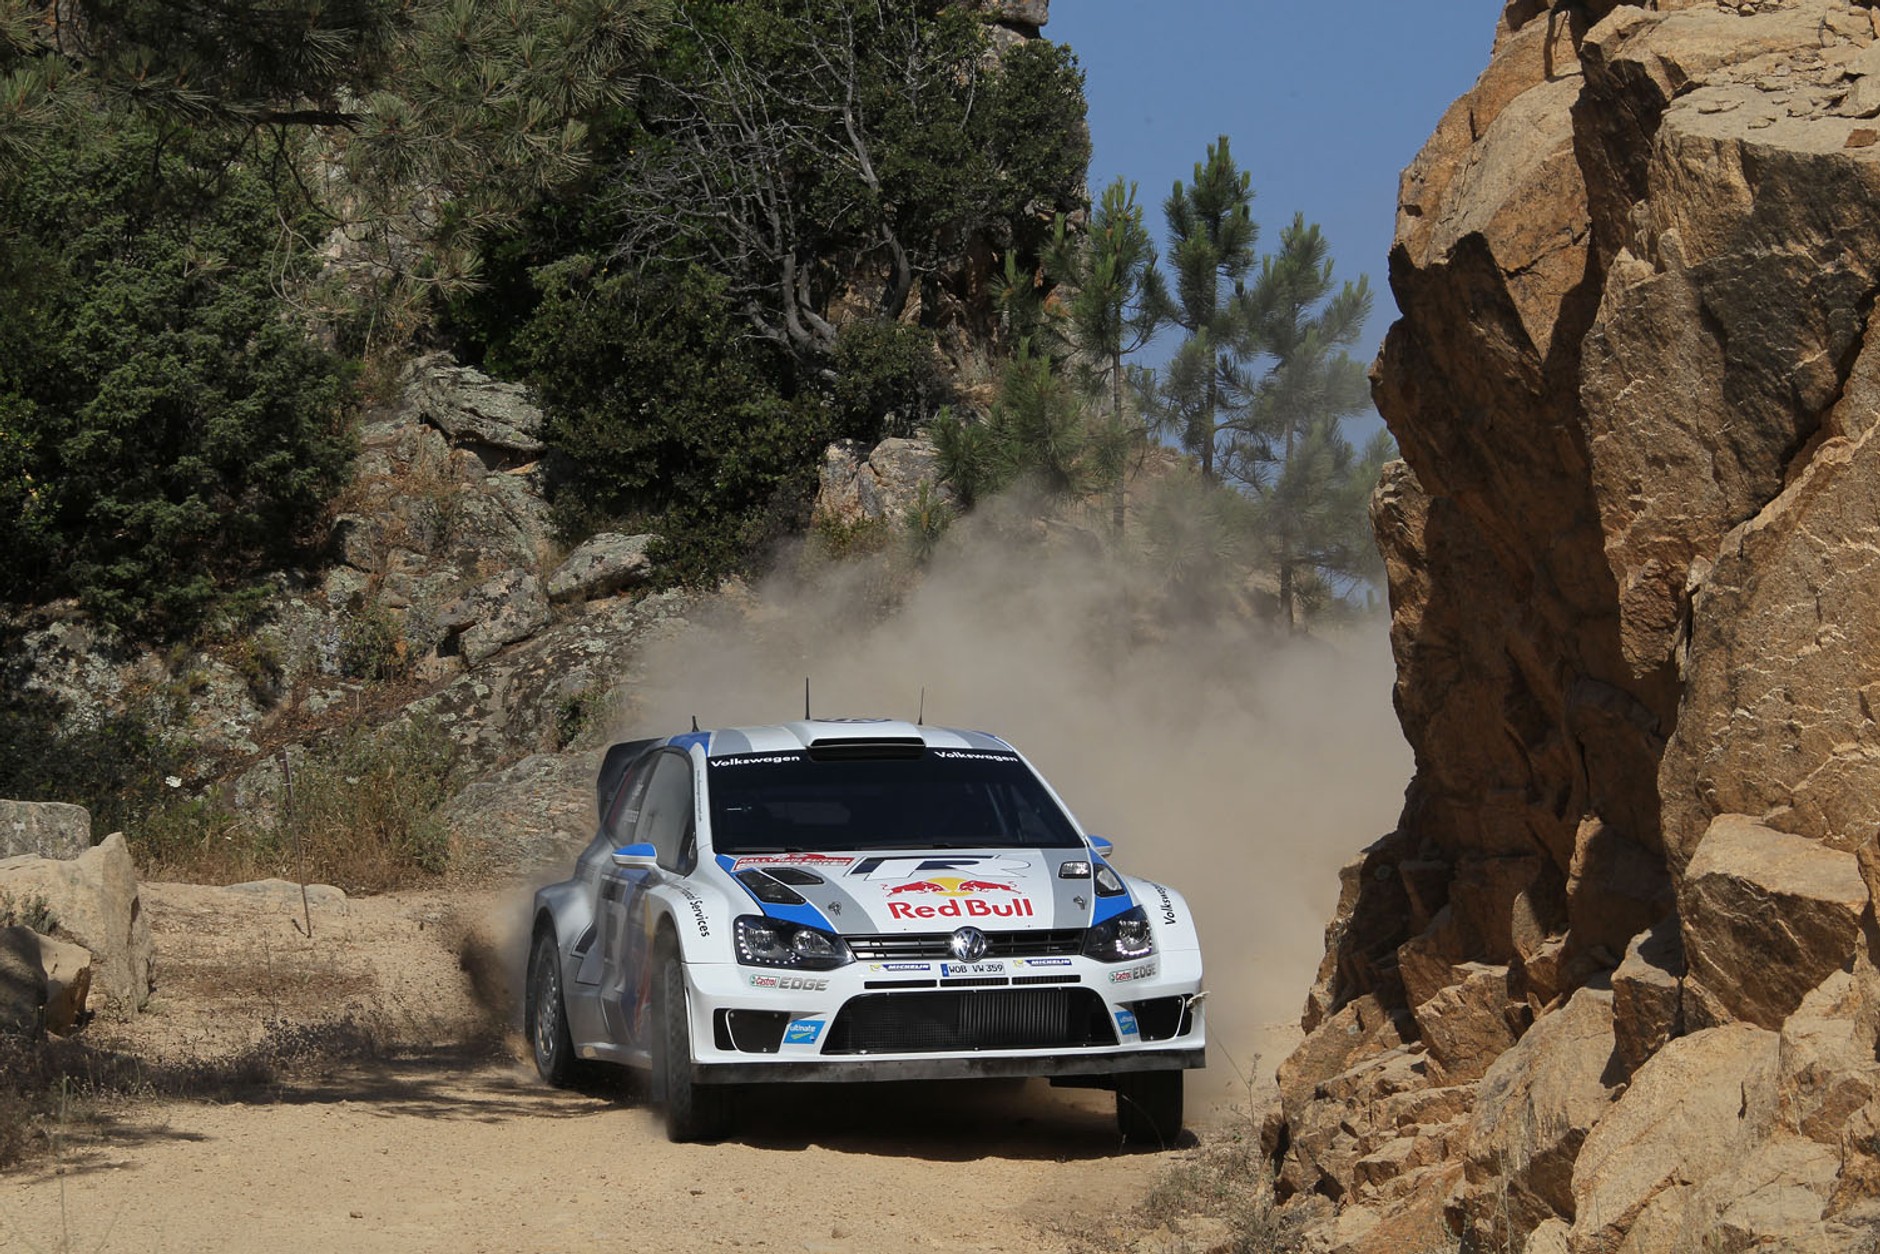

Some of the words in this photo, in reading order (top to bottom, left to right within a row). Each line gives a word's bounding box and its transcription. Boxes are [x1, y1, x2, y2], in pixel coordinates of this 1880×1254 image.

[710, 755, 800, 767] Volkswagen
[934, 751, 1018, 762] Volkswagen
[887, 899, 957, 919] Red
[964, 898, 1034, 917] Bull
[690, 900, 710, 937] Services
[949, 964, 968, 974] WOB
[974, 964, 985, 973] VW
[986, 963, 1004, 973] 359
[1133, 963, 1156, 979] EDGE
[779, 976, 830, 991] EDGE
